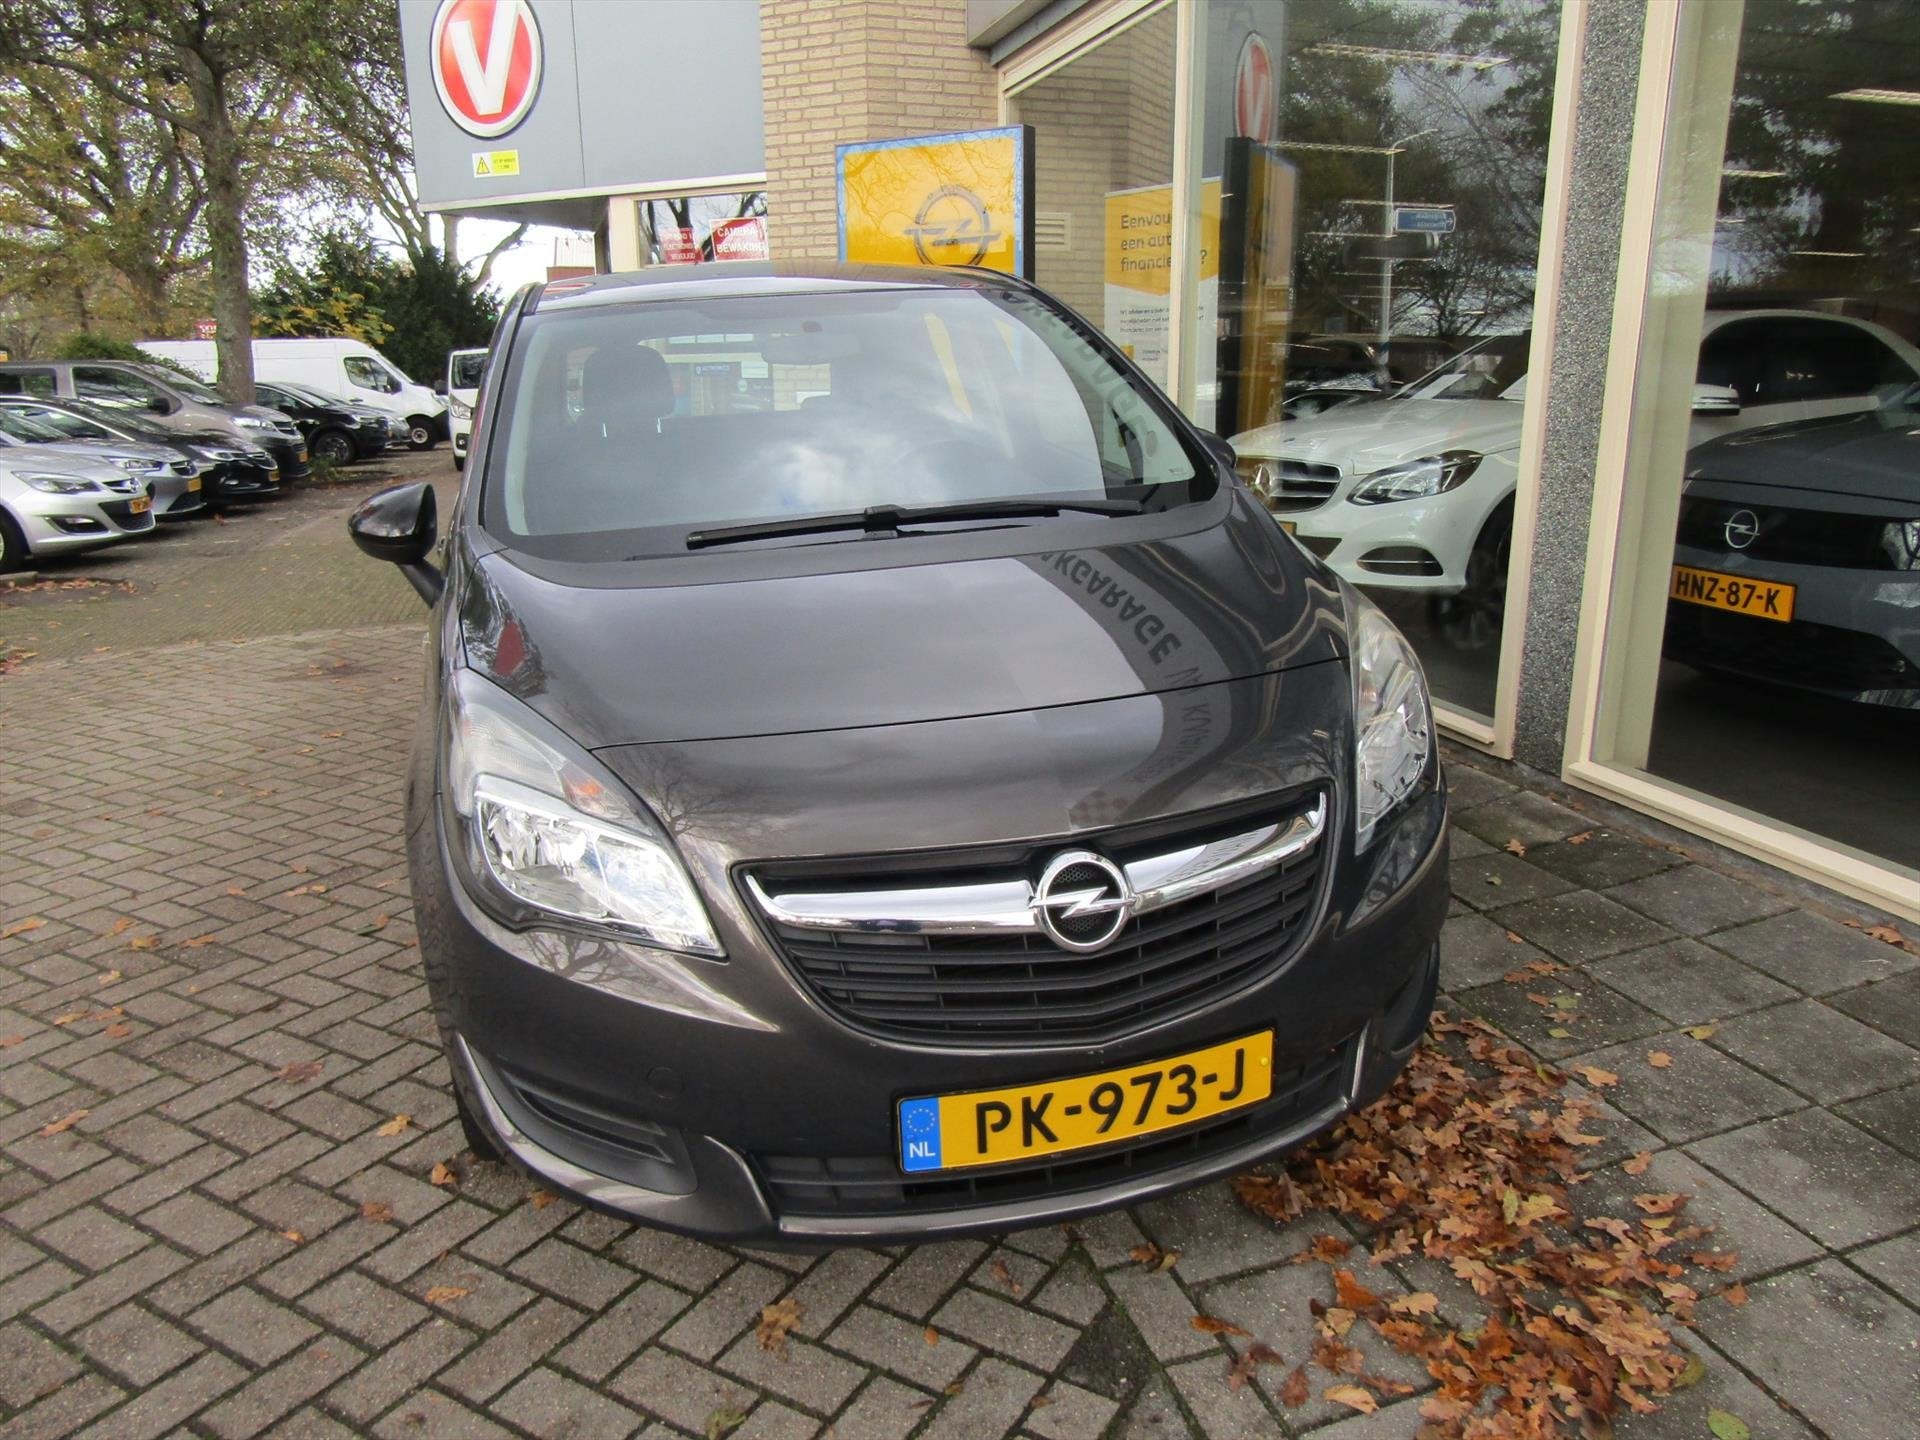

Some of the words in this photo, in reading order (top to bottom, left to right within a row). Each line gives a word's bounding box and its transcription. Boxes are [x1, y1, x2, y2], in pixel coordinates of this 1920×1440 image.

[447, 0, 519, 115] V
[1121, 212, 1172, 229] Eenvou
[1120, 238, 1145, 250] een
[1147, 233, 1172, 247] aut
[1675, 571, 1780, 615] HNZ-87-K
[975, 1048, 1246, 1154] PK-973-J
[909, 1141, 936, 1159] NL
